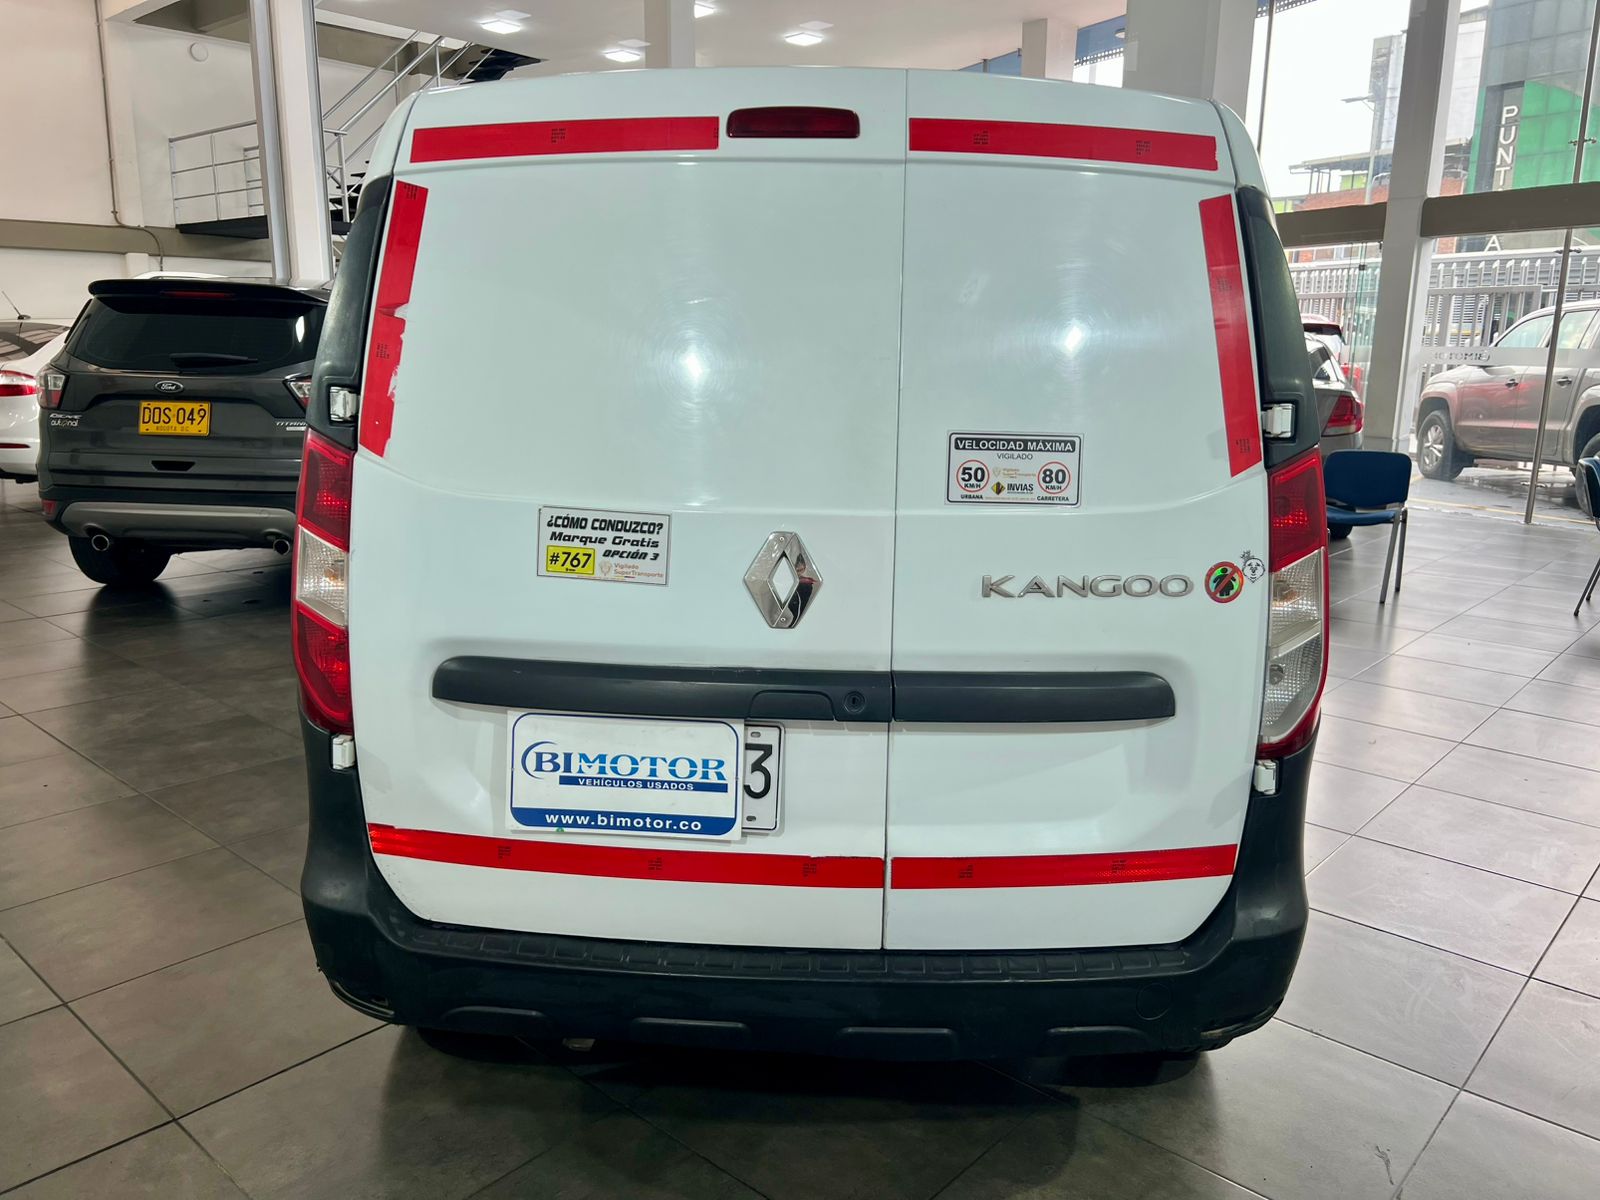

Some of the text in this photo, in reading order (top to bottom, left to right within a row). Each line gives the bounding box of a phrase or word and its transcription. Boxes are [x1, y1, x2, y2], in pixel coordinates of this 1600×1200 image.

[1495, 105, 1519, 192] PUNT
[142, 406, 207, 426] DOS 049
[957, 439, 1073, 451] VELOCIDAD MÁXIMA
[996, 452, 1033, 461] VIGILADO
[960, 466, 986, 483] 50
[1041, 468, 1067, 484] 80
[1007, 483, 1034, 492] INVIAS
[547, 513, 664, 535] ¿CÓMO CONDUZCO?
[549, 531, 660, 548] Marque Gratis
[549, 551, 592, 569] #767
[650, 552, 660, 561] 3
[614, 562, 639, 570] Vigilado
[981, 574, 1194, 598] KANGOO
[532, 751, 727, 781] BIMOTOR
[743, 743, 773, 799] 3
[578, 776, 695, 791] VEHÍCULOS USADOS
[545, 813, 702, 831] www.bimotor.co
